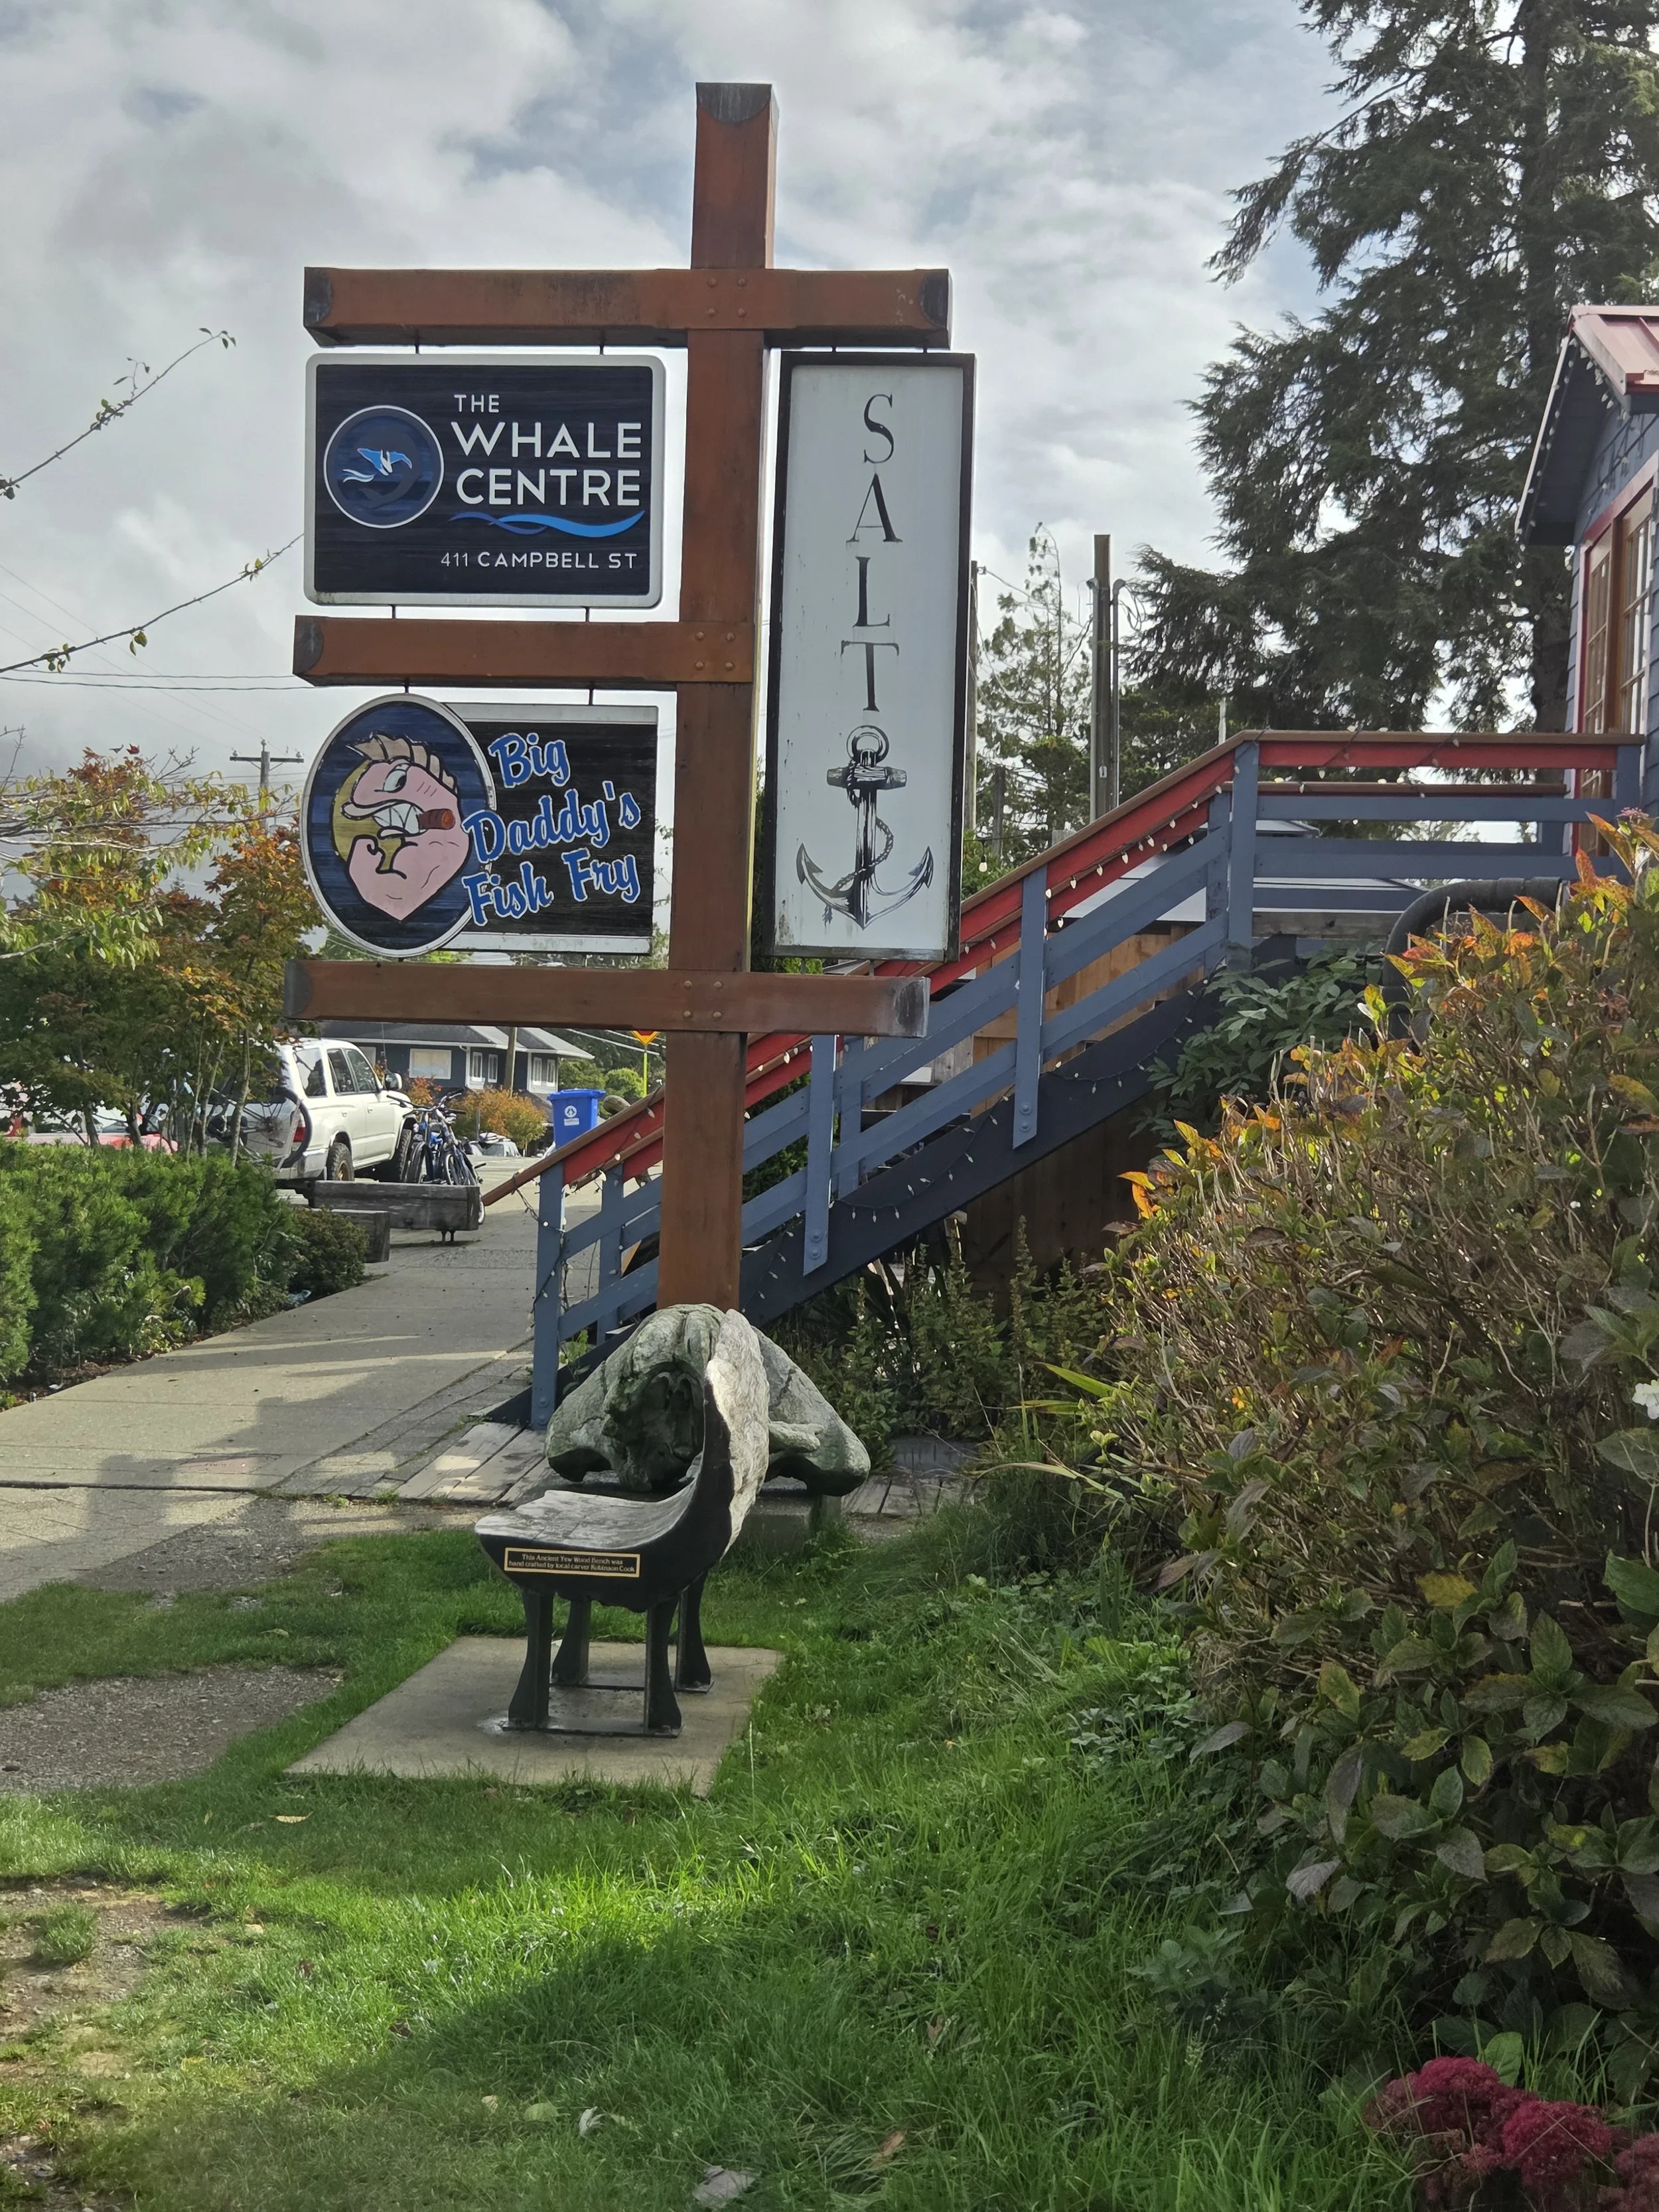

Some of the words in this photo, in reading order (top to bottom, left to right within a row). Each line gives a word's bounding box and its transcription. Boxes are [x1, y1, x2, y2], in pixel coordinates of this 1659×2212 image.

[454, 394, 500, 413] THE
[451, 421, 642, 458] WHALE
[456, 469, 640, 506] CENTRE
[441, 552, 469, 567] 411
[478, 552, 599, 569] CAMPBELL
[609, 553, 637, 569] ST
[840, 394, 903, 711] SALT
[490, 732, 570, 788] Big
[462, 780, 641, 863] Daddy's
[462, 861, 554, 926] Fish
[561, 848, 640, 903] Fry
